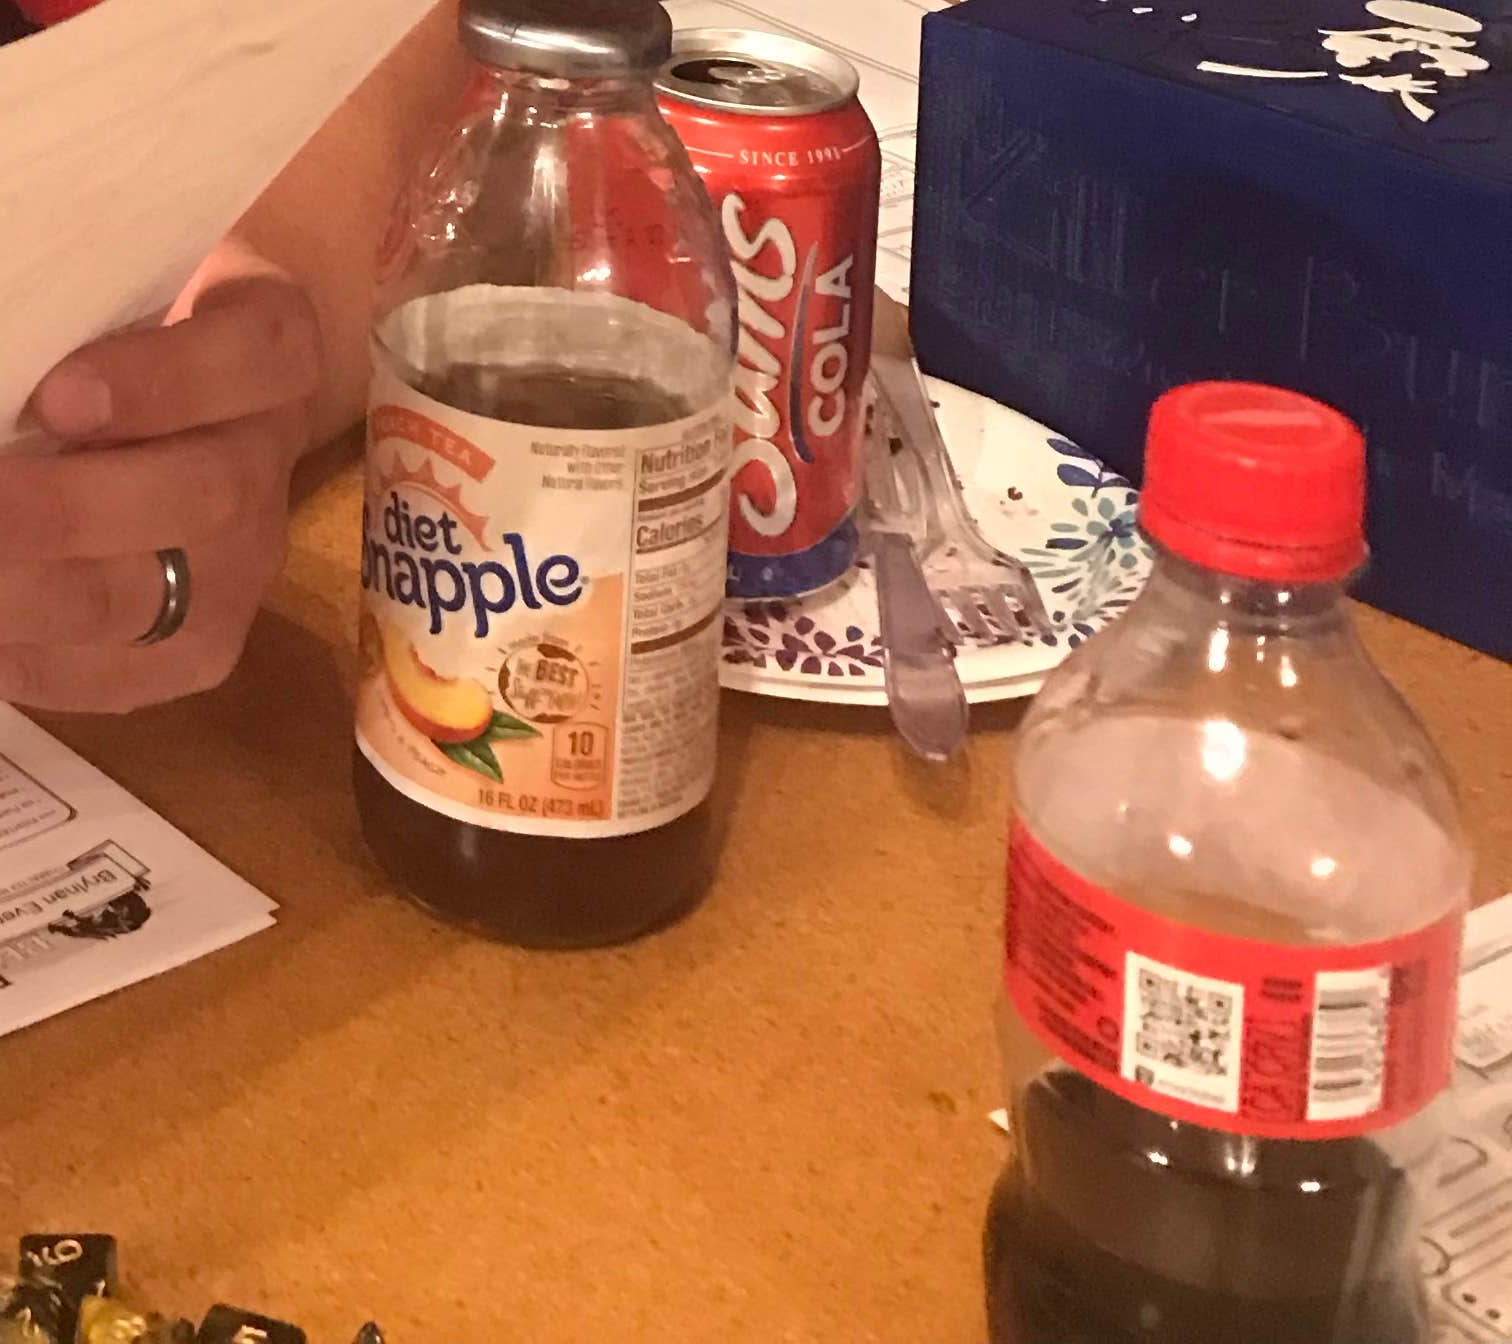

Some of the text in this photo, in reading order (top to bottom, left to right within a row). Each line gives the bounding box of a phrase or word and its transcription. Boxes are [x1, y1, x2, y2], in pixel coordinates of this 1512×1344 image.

[739, 149, 799, 167] SINCE
[808, 254, 854, 437] COLA
[385, 491, 462, 556] diet
[637, 514, 704, 546] Calories
[536, 659, 578, 688] BEST
[569, 731, 594, 756] 10
[478, 789, 494, 807] 16
[498, 792, 515, 810] FL
[519, 794, 538, 814] OZ
